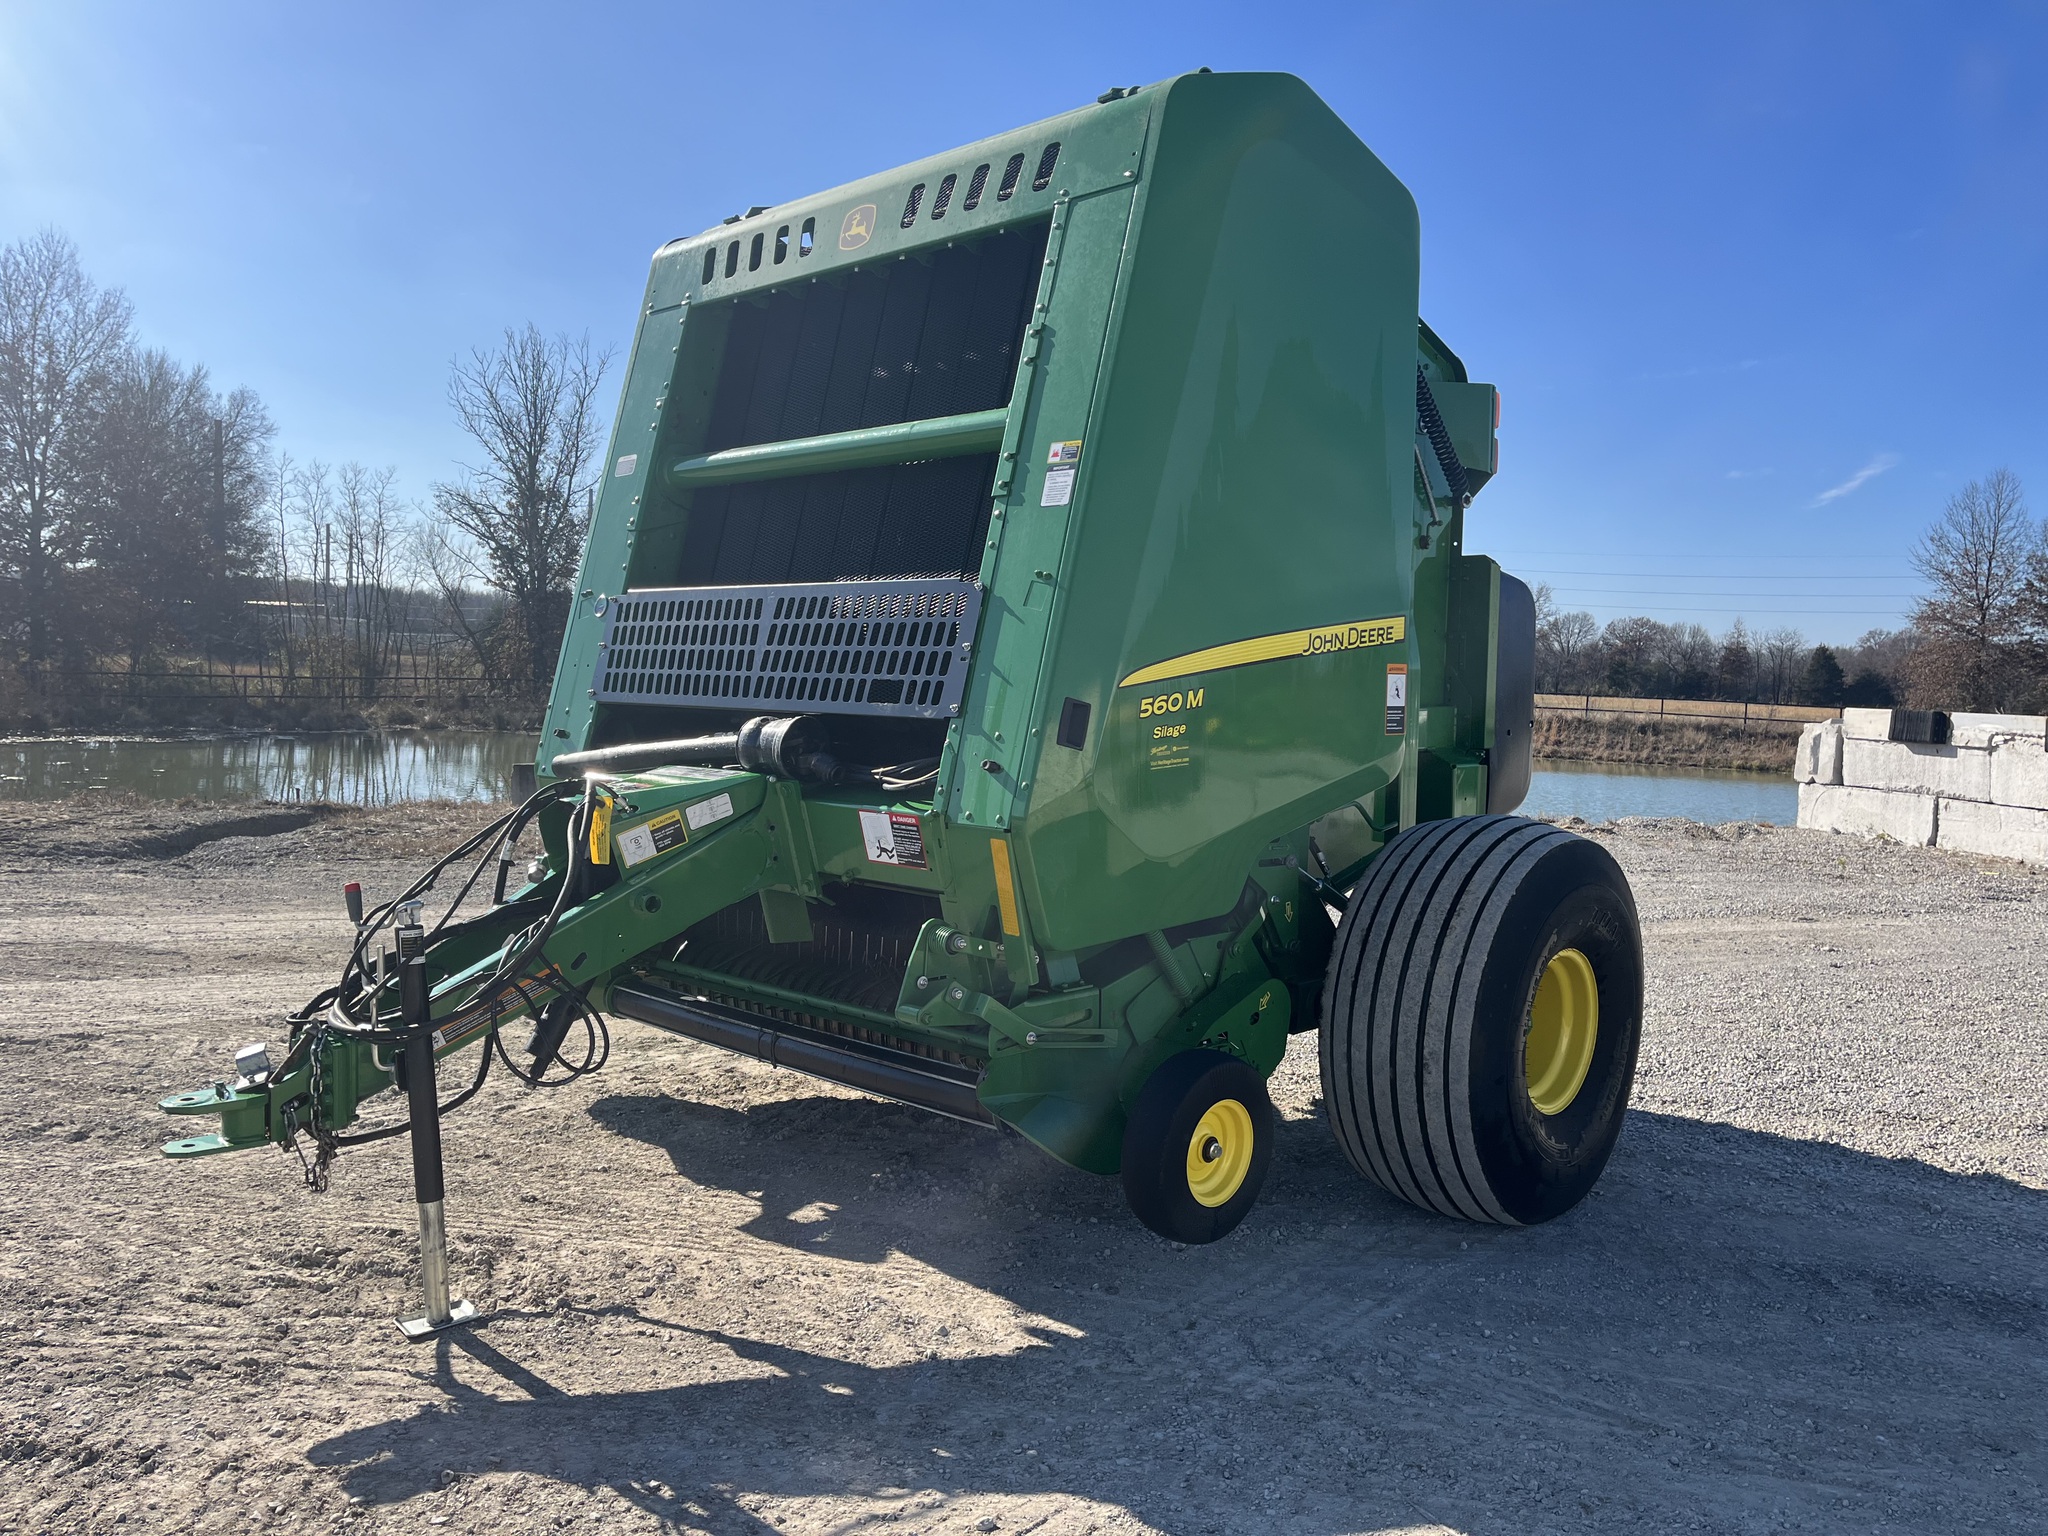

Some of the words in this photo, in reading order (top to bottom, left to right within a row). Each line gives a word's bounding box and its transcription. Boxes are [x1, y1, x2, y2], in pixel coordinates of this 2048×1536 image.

[1348, 626, 1394, 646] DEERE
[1139, 692, 1183, 718] 560
[1186, 688, 1205, 710] M
[1152, 724, 1187, 739] Silage
[655, 814, 676, 826] CAUTION
